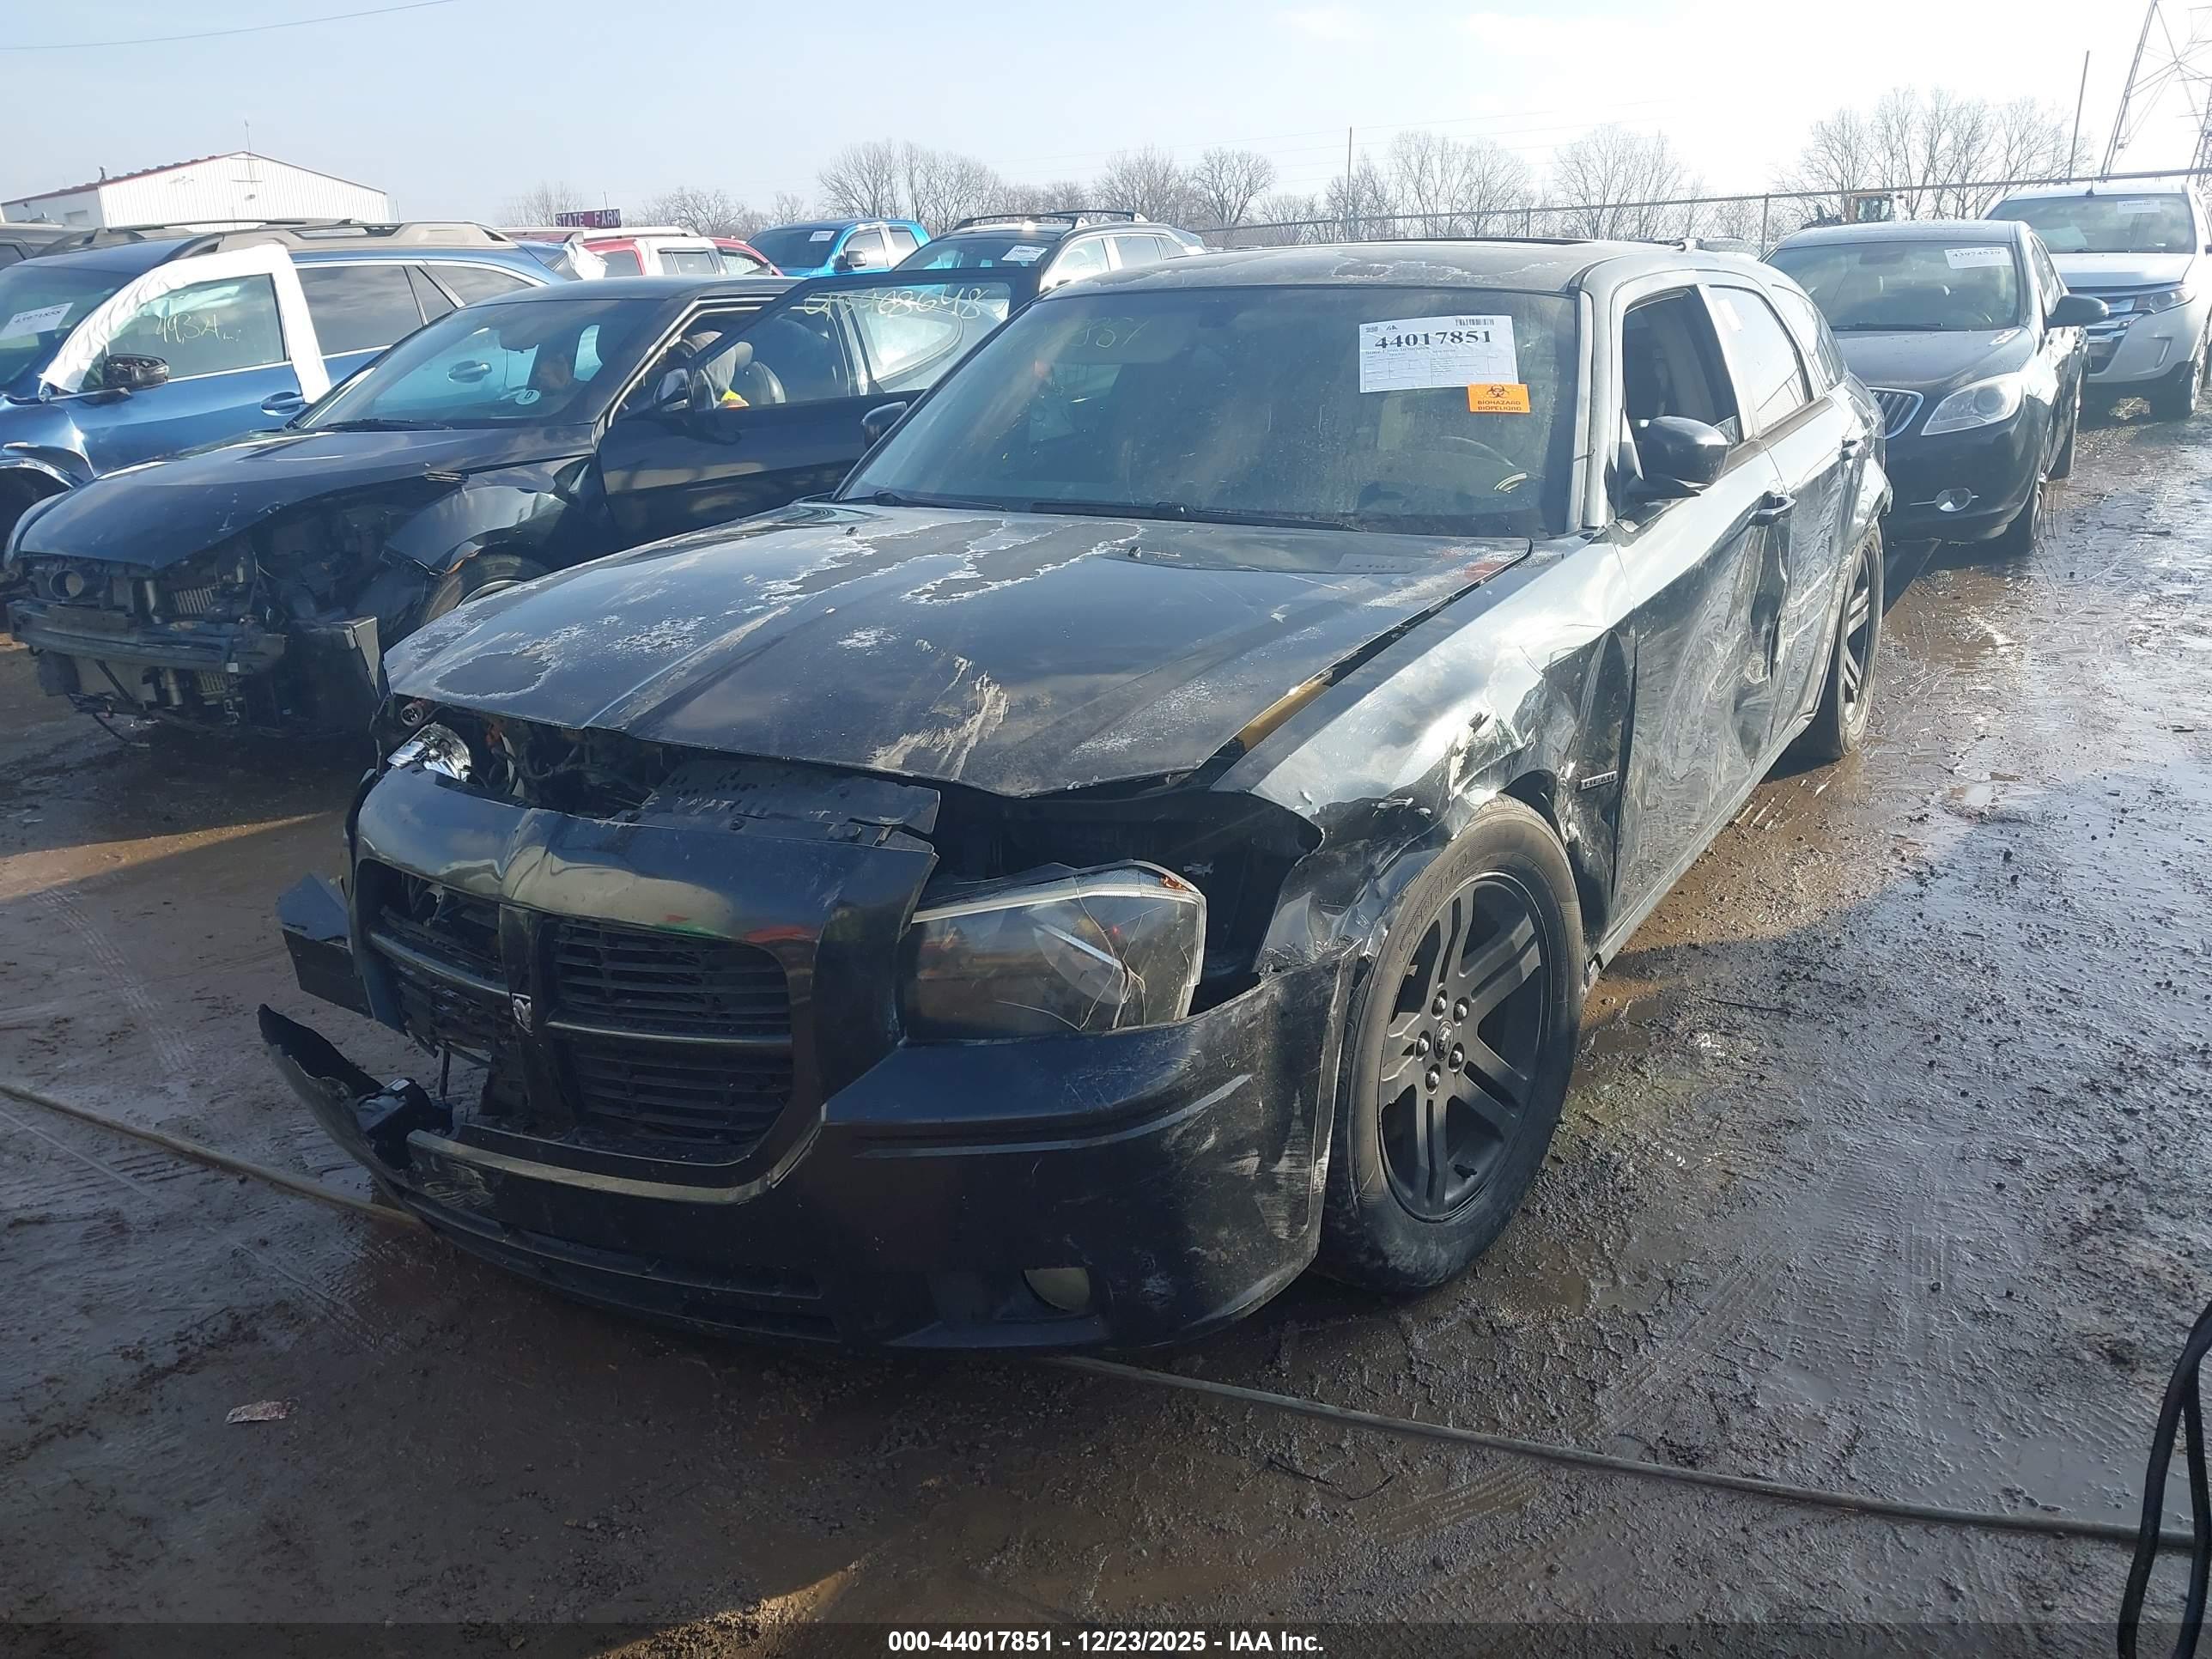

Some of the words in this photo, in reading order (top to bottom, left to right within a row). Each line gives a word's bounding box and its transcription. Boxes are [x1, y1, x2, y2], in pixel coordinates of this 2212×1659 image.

[556, 212, 585, 227] STATE
[594, 210, 620, 227] FARM
[1375, 331, 1491, 349] 44017851
[1584, 774, 1615, 787] HEMI
